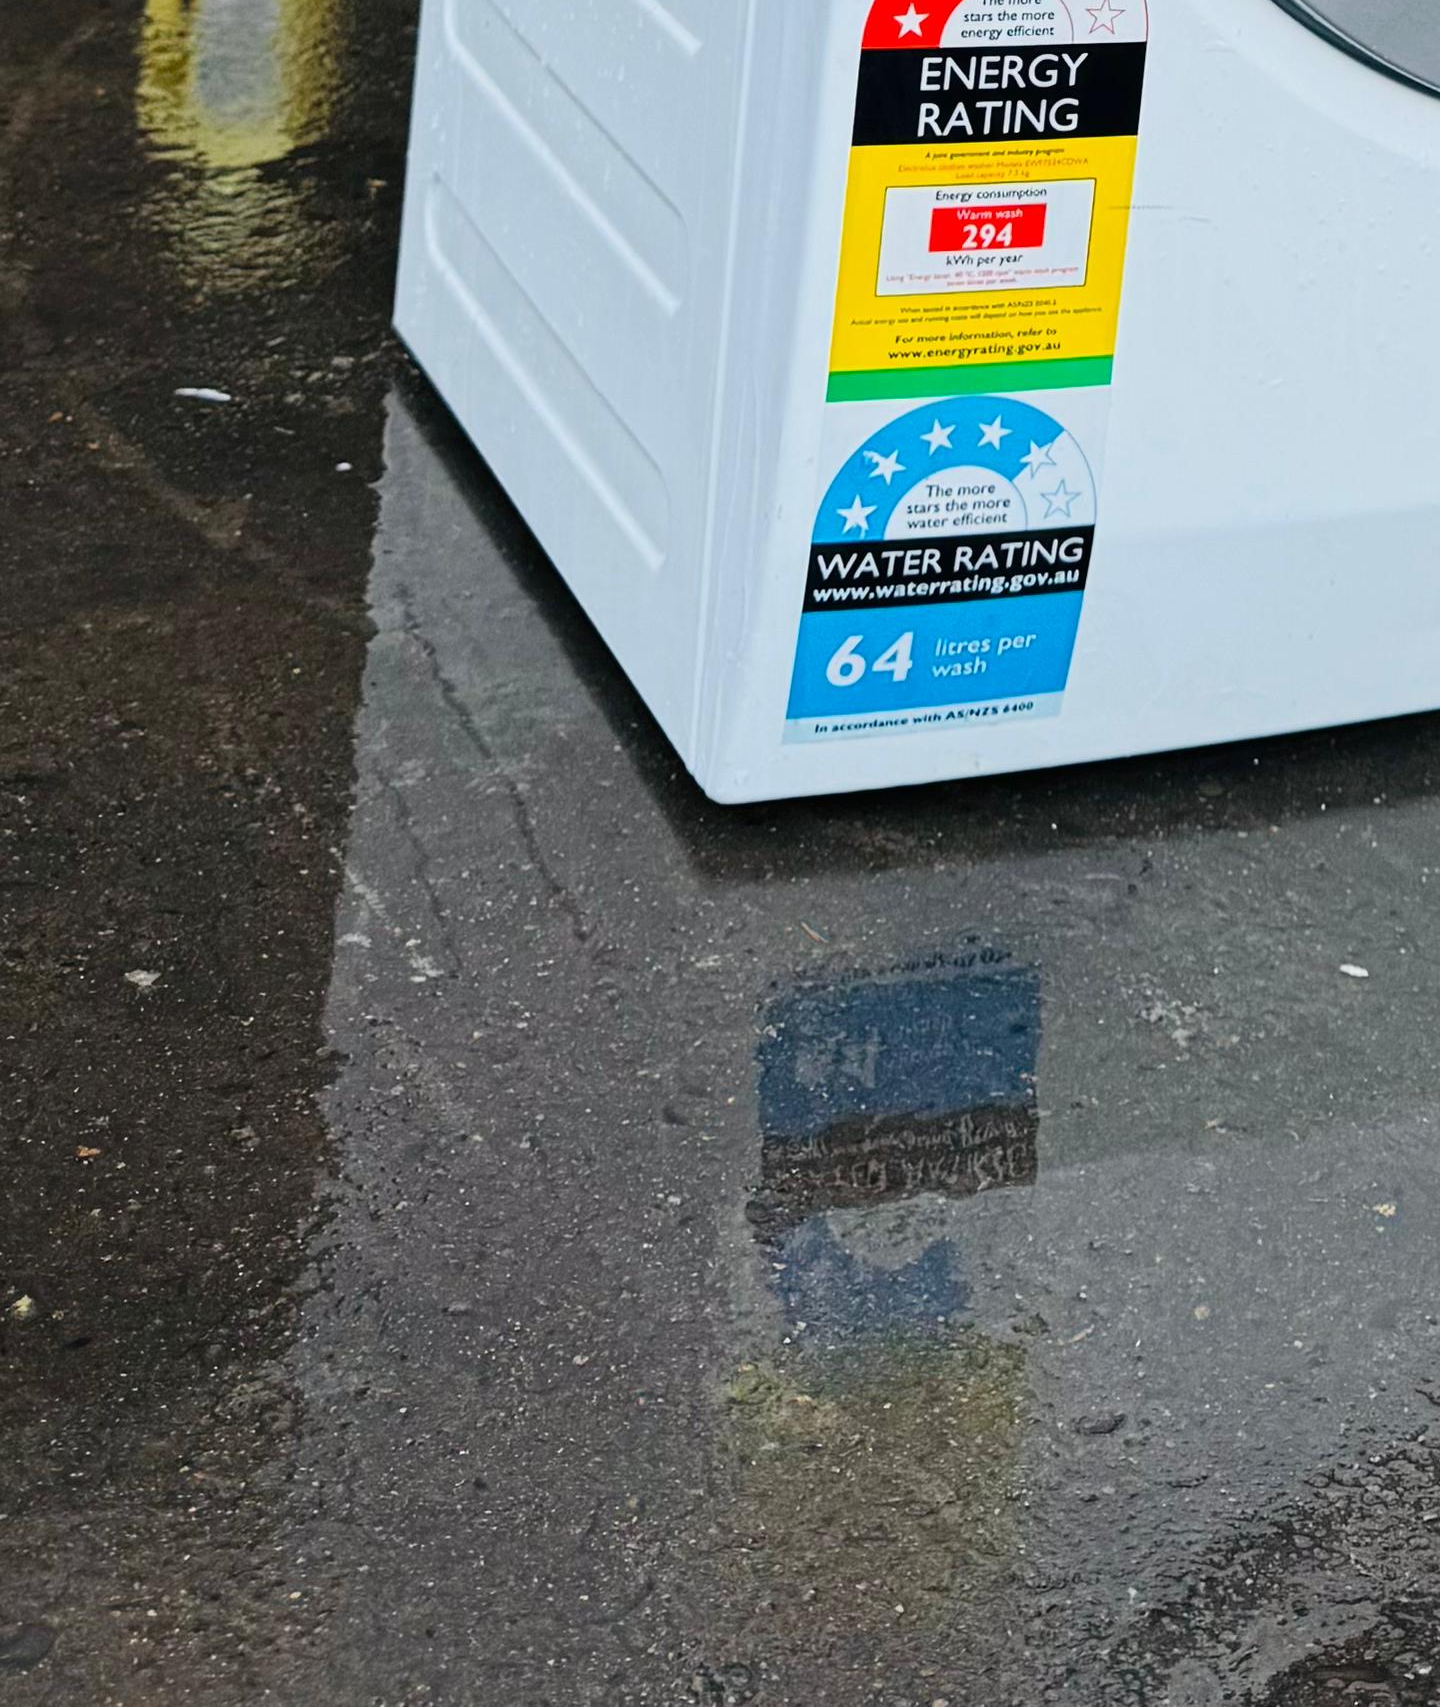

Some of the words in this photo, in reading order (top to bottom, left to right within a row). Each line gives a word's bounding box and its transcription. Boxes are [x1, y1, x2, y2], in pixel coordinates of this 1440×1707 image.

[963, 12, 993, 23] stars
[997, 9, 1018, 22] the
[1021, 10, 1055, 21] more
[960, 27, 1003, 41] energy
[1006, 24, 1055, 38] efficient
[919, 52, 1089, 93] ENERGY
[916, 97, 1081, 137] RATING
[935, 190, 972, 203] Energy
[976, 187, 1048, 201] consumption
[957, 208, 992, 221] Warm
[995, 207, 1023, 219] wash
[962, 222, 1013, 250] 294
[946, 254, 974, 267] kWh
[976, 256, 995, 268] per
[998, 253, 1024, 267] year
[895, 335, 914, 344] For
[916, 334, 946, 343] more
[1017, 327, 1042, 337] refer
[1046, 327, 1057, 336] to
[888, 342, 1061, 360] www.energyrating.gov.au
[926, 484, 954, 499] The
[957, 483, 996, 496] more
[906, 502, 940, 515] stars
[945, 498, 968, 512] the
[972, 497, 1011, 510] more
[906, 516, 948, 530] water
[952, 512, 1008, 528] efficient
[816, 547, 942, 582] WATER
[953, 535, 1084, 574] RATING
[812, 568, 1080, 604] www.waterrating.gov.au
[934, 637, 991, 658] litres
[996, 633, 1037, 655] per
[824, 631, 915, 687] 64
[931, 655, 988, 679] wash
[814, 723, 828, 734] In
[831, 716, 909, 732] accordance
[912, 712, 942, 725] with
[945, 704, 999, 722] AS/NZS
[1002, 700, 1035, 714] 6400
